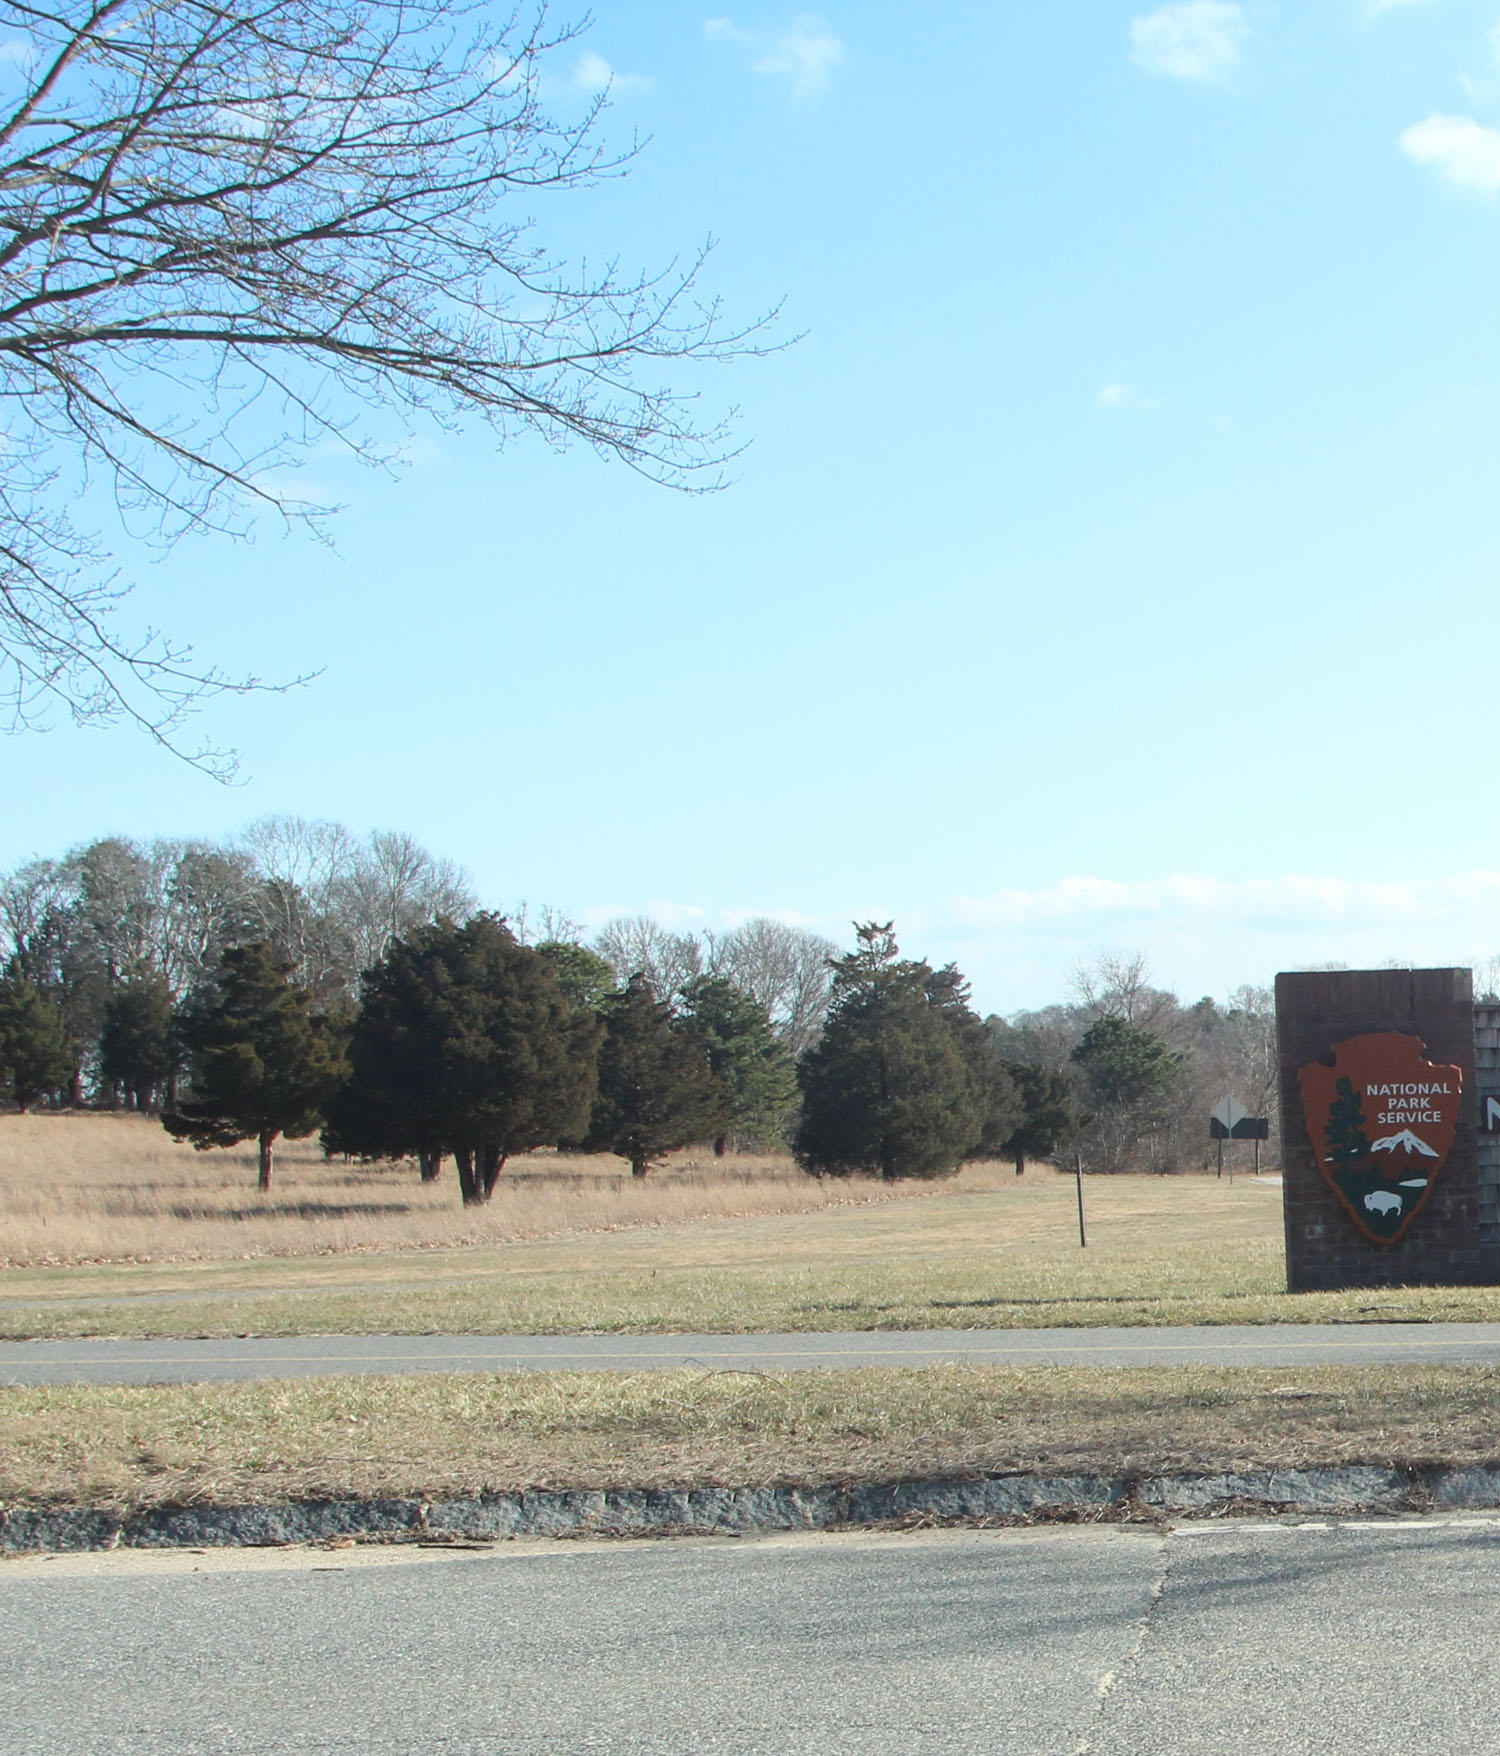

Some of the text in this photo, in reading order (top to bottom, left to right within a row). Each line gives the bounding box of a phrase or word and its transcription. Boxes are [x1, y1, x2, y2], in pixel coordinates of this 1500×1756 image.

[1367, 1083, 1451, 1095] NATIONAL
[1389, 1098, 1430, 1109] PARK
[1378, 1111, 1441, 1123] SERVICE
